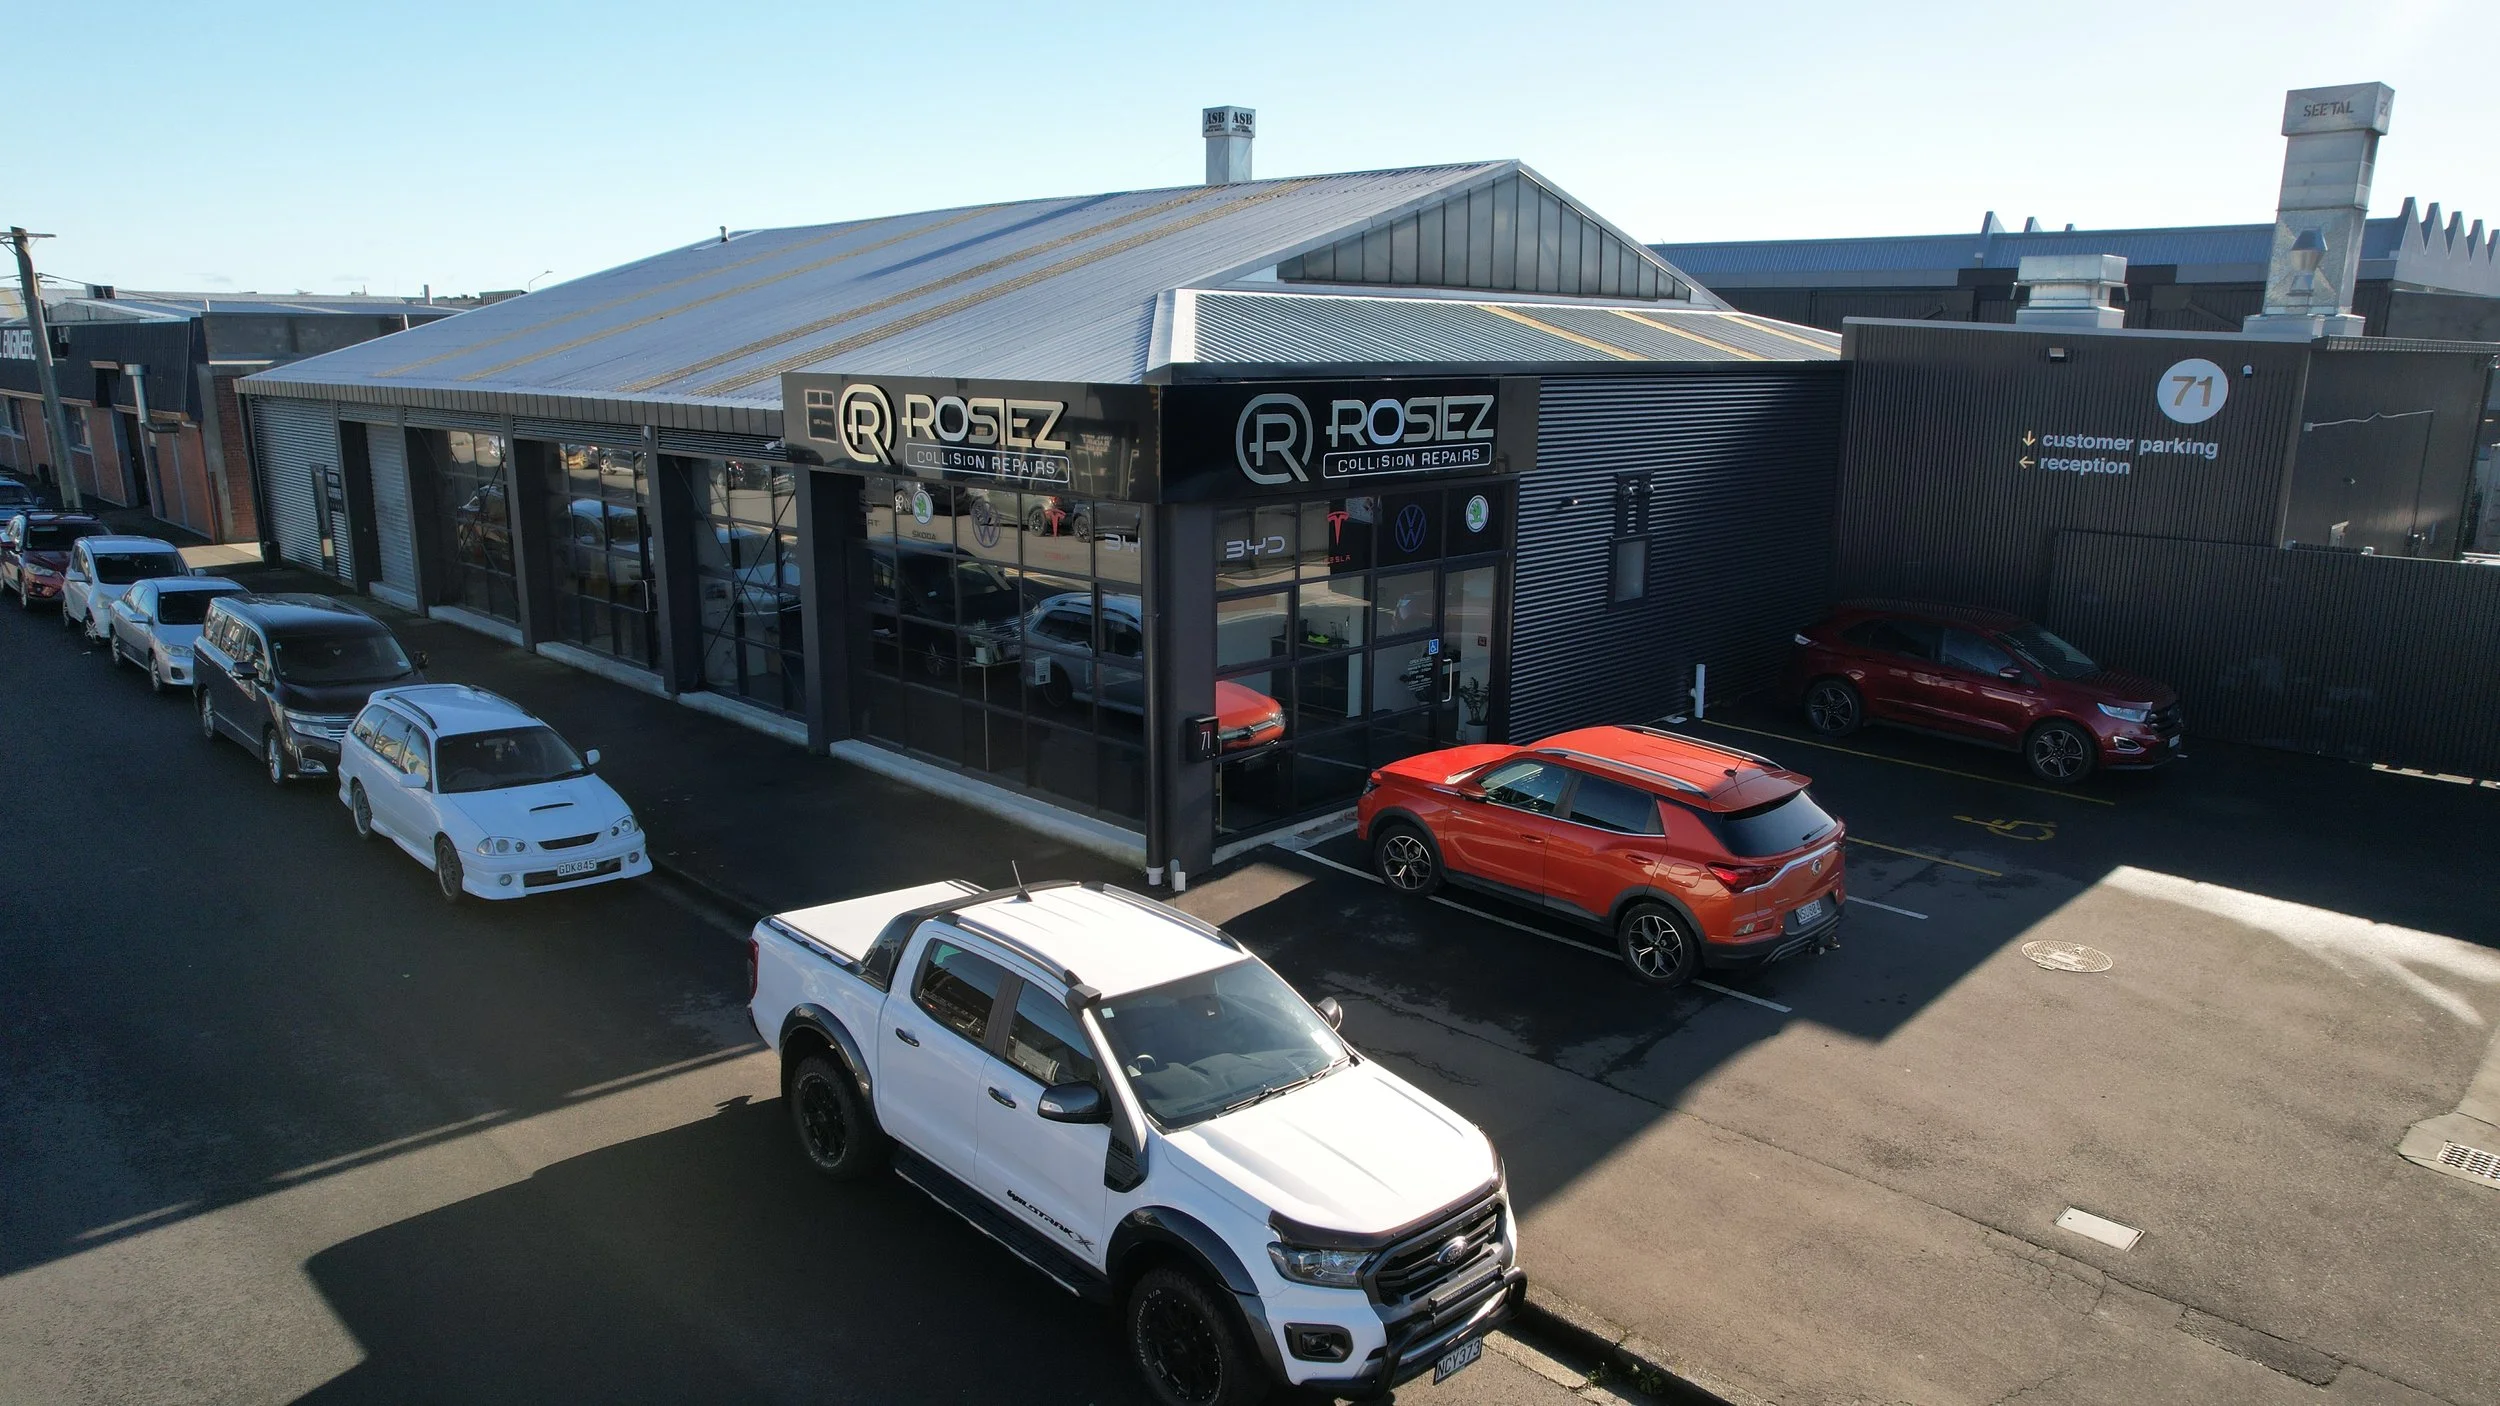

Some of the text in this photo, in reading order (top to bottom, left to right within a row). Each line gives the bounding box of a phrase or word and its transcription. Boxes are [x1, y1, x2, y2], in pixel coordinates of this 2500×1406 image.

[1205, 111, 1225, 125] ASB
[1232, 111, 1253, 126] ASB
[2172, 375, 2214, 408] 71
[902, 393, 1068, 451] ROSTEZ
[1326, 394, 1495, 448] ROSTEZ
[2042, 433, 2219, 460] customer parking
[917, 450, 1056, 476] COLLISION REPAIRS
[1337, 448, 1480, 473] COLLISION REPAIRS
[2039, 456, 2131, 476] reception
[1226, 535, 1286, 559] BYD
[1201, 730, 1211, 751] 71
[559, 860, 596, 875] GDK845
[1436, 1339, 1481, 1379] NCY373
